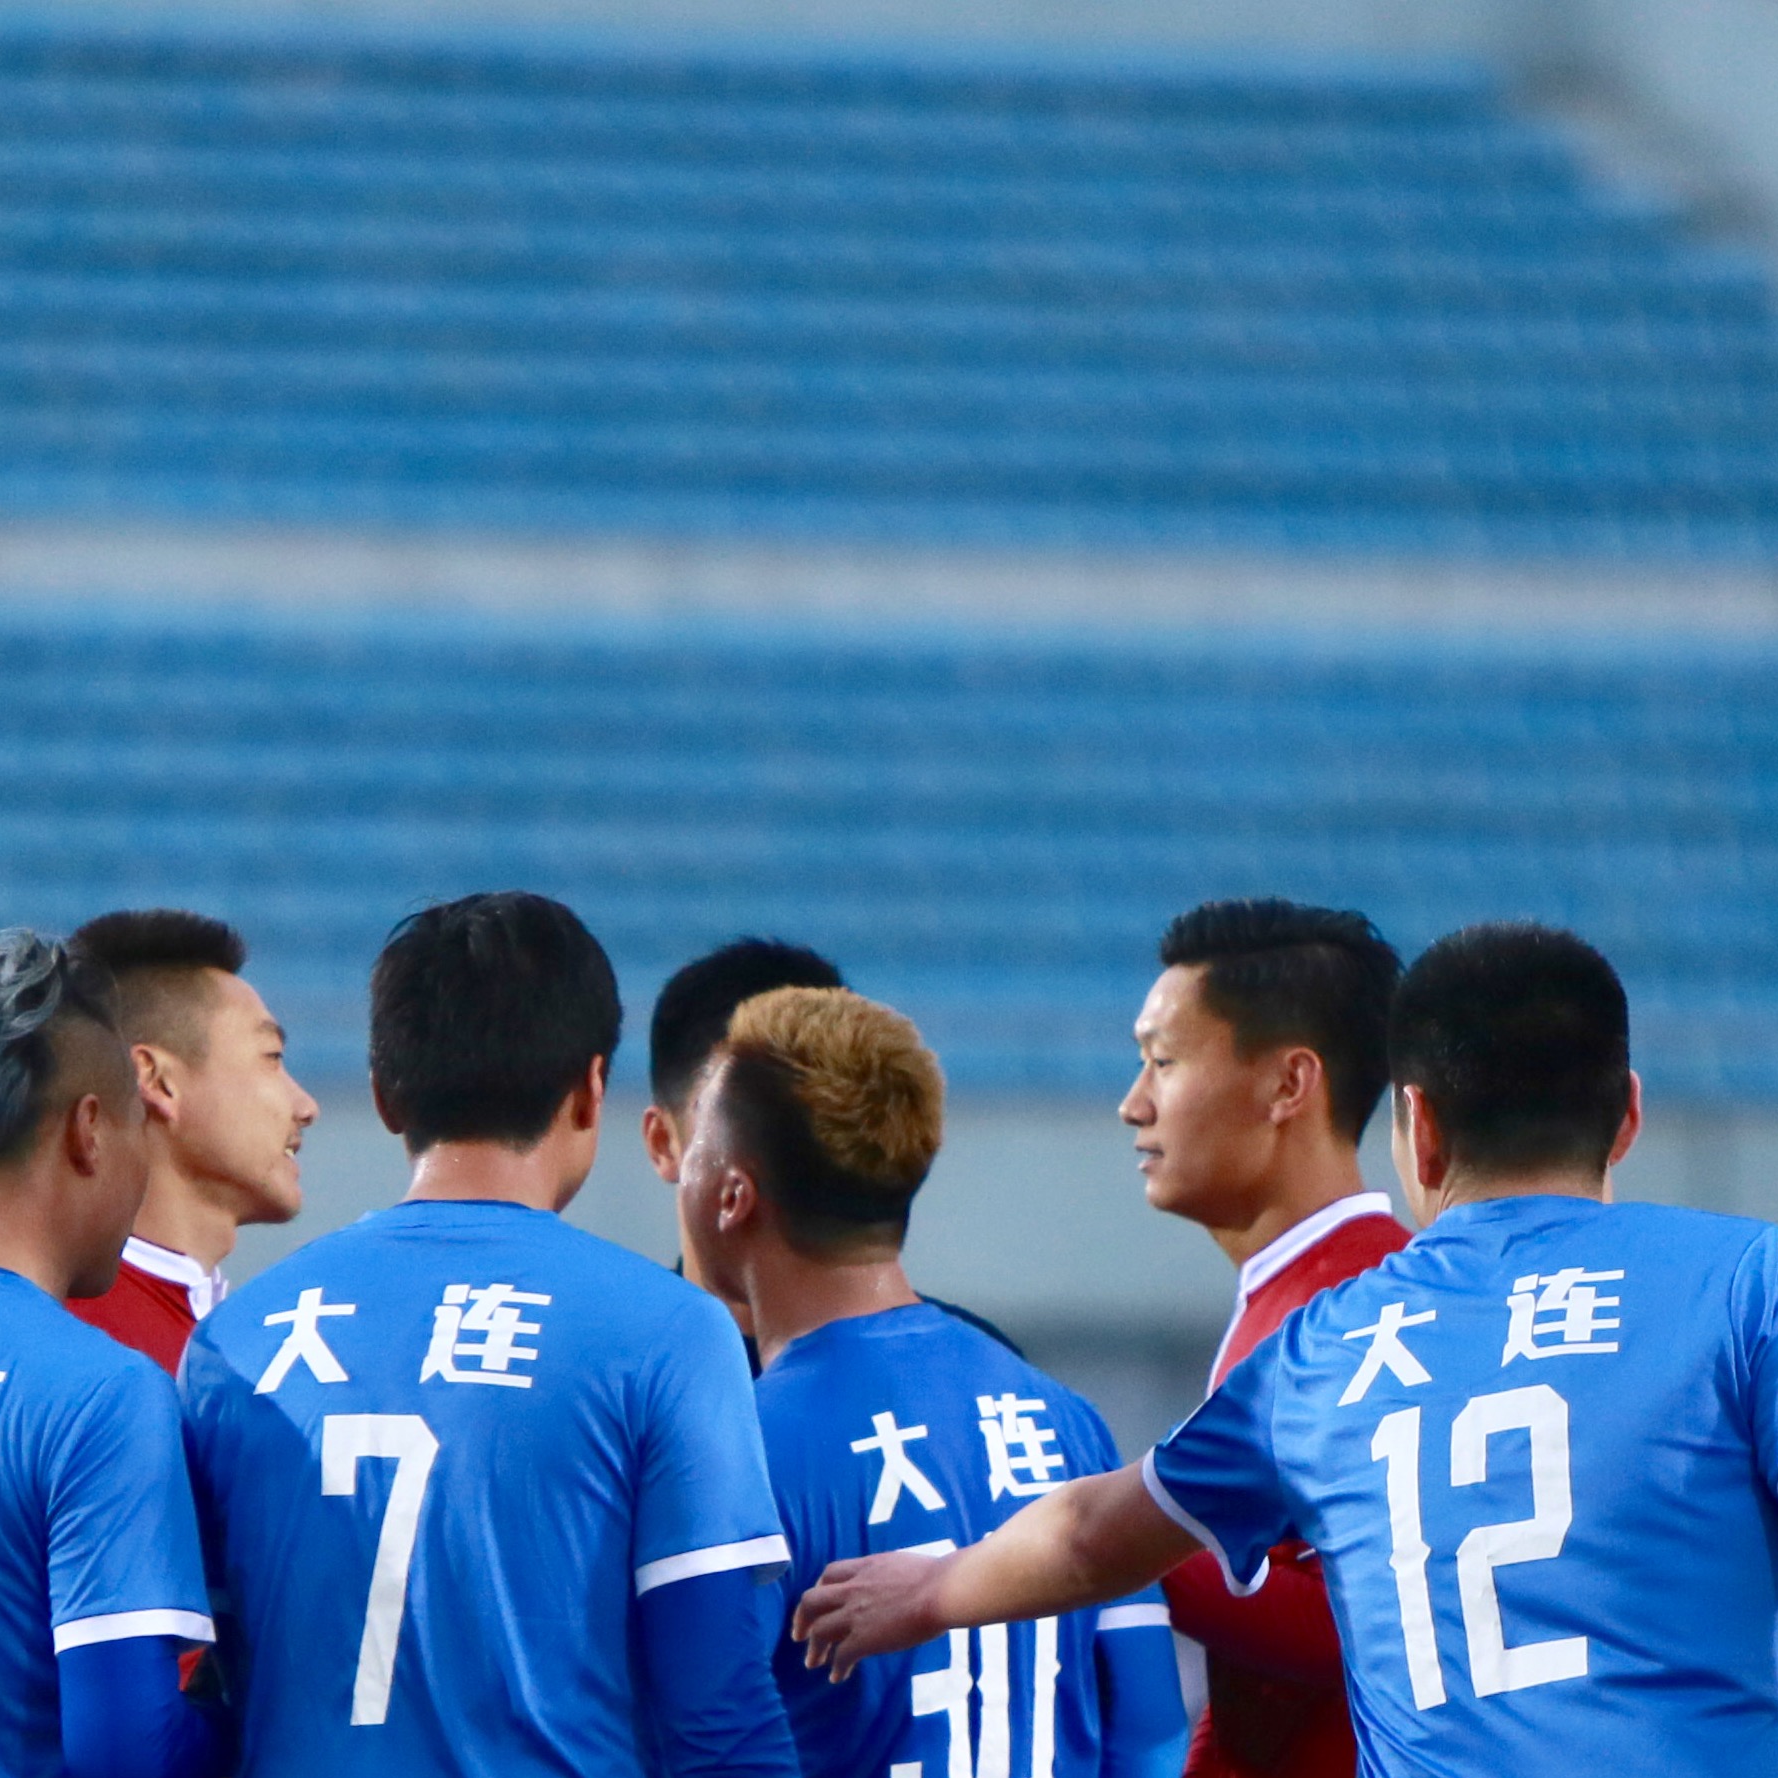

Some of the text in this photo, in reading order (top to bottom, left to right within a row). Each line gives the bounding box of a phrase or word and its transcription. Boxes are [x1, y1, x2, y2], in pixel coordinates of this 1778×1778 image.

[254, 1283, 552, 1395] 大连
[1337, 1267, 1625, 1406] 大连
[850, 1393, 1069, 1525] 大连
[322, 1414, 440, 1726] 7
[1370, 1384, 1589, 1712] 12
